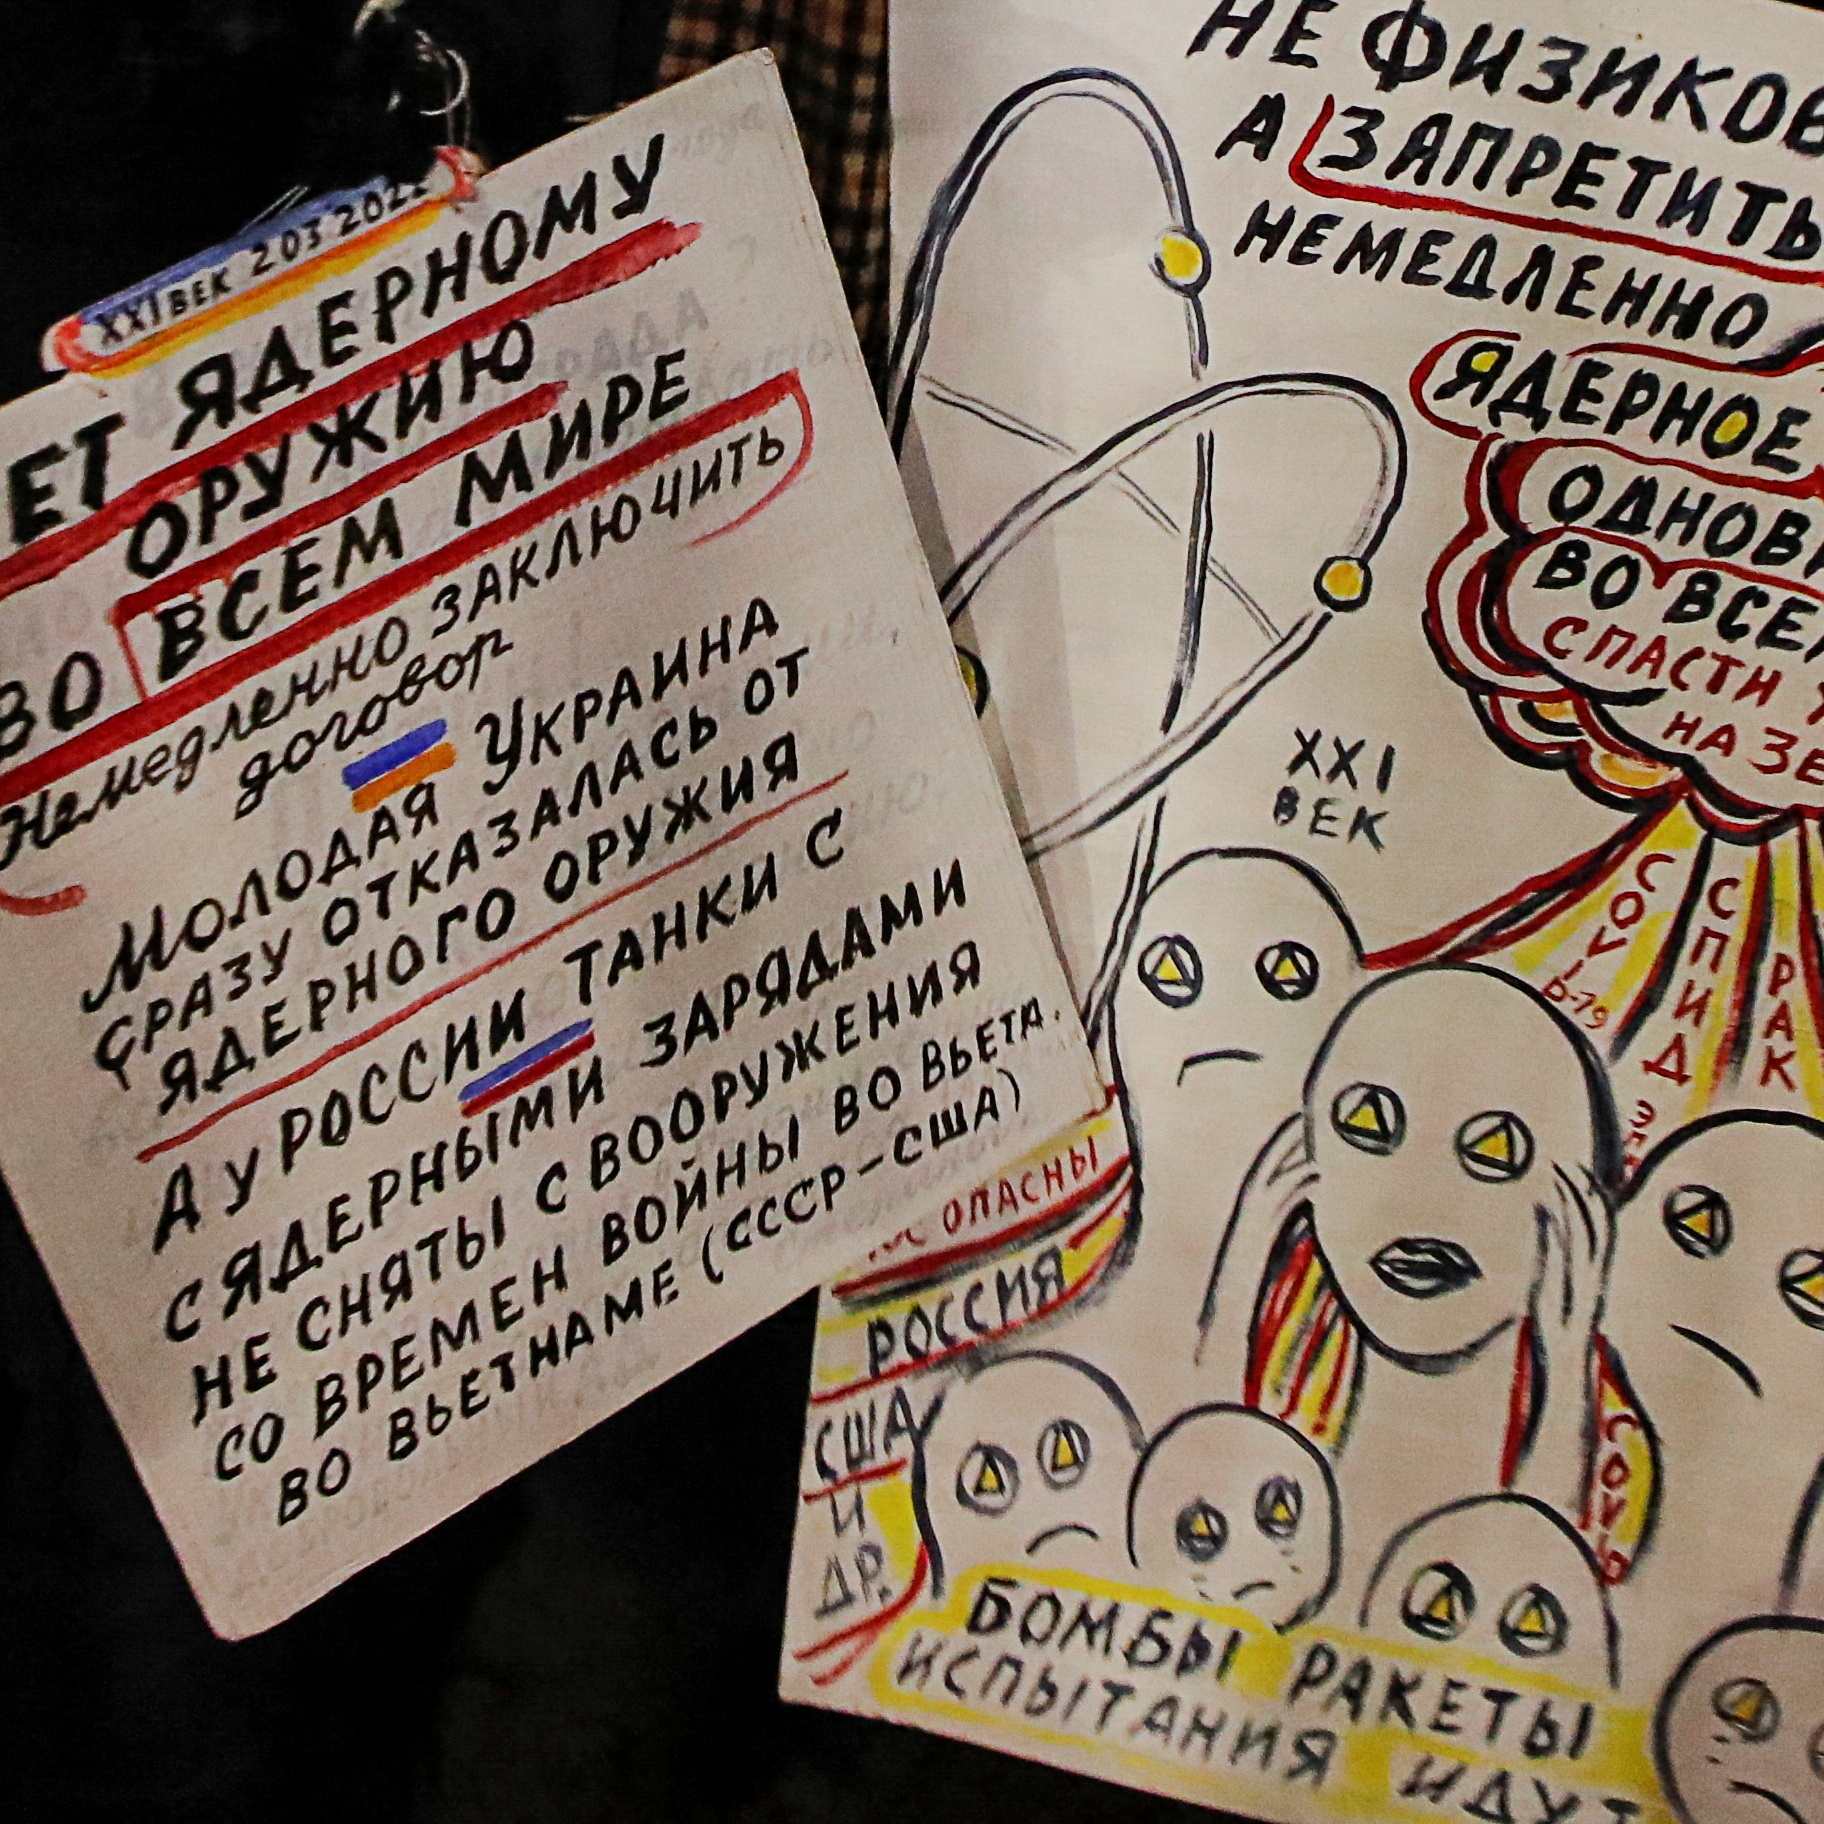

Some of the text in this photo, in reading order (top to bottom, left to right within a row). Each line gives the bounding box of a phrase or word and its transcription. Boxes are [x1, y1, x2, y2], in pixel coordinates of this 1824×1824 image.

[1214, 93, 1821, 261] А ЗАПРЕТИТЬ
[173, 133, 665, 450] ЯДЕРНОМУ
[1234, 199, 1768, 350] НЕМЕДЛЕННО
[126, 321, 534, 578] ОРУЖИЮ
[1434, 339, 1813, 478] ЯДЕРНОЕ
[156, 499, 402, 681] ВСЕМ
[456, 349, 691, 526] МИРЕ
[431, 427, 784, 638] ЗАКЛЮЧИТЬ
[1536, 539, 1641, 612] ВО
[234, 629, 513, 819] договор
[1543, 616, 1784, 710] СПАСТИ
[1662, 712, 1738, 757] НА
[81, 597, 779, 1011] МОЛОДАЯ УКРАИНА
[1273, 785, 1389, 854] ВЕК
[1286, 727, 1396, 793] XXI
[95, 648, 809, 1090] СРАЗУ ОТКАЗАЛАСЬ ОТ
[159, 732, 798, 1115] ЯДЕРНОГО ОРУЖИЯ
[154, 808, 843, 1252] А У РОССИИ ТАНКИ С
[1642, 878, 1741, 1086] СПИД
[1760, 953, 1796, 1092] РАК
[164, 859, 966, 1342] С ЯДЕРНЫМИ ЗАРЯДАМИ
[193, 939, 981, 1428] НЕ СНЯТЫ С ВООРУЖЕНИЯ
[941, 1135, 1098, 1235] ОПАСНЫ
[215, 1411, 283, 1480] СО
[315, 1245, 568, 1439] ВРЕМЕН
[601, 1114, 799, 1266] ВОЙНЫ
[834, 1066, 902, 1135] ВО
[868, 1245, 1065, 1377] РОССИЯ
[278, 1449, 351, 1525] ВО
[388, 1258, 679, 1461] ВЬЕТНАМЕ
[815, 1385, 918, 1481] США
[898, 1630, 1336, 1791] ИСПЫТАНИЯ
[966, 1577, 1594, 1759] БОМБЫ РАКЕТЫ
